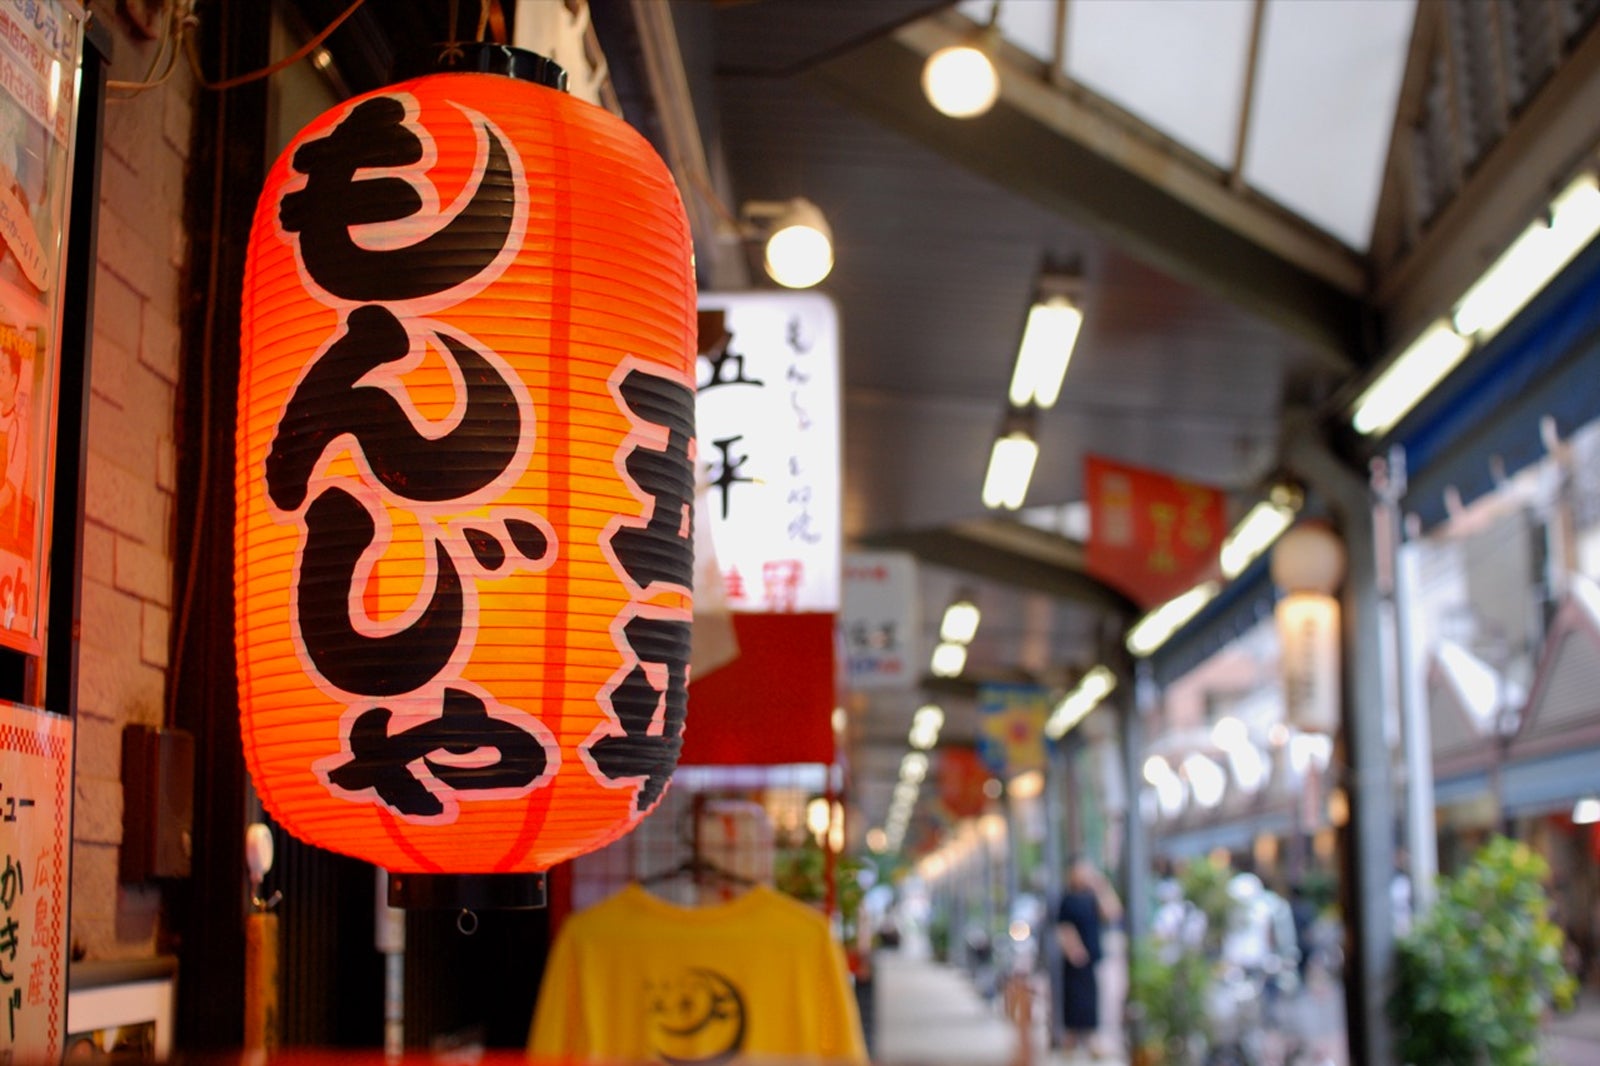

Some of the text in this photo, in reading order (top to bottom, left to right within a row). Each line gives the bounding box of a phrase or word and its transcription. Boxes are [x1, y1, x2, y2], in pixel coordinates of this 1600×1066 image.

[0, 782, 35, 822] ュー
[28, 848, 51, 1006] 広島産
